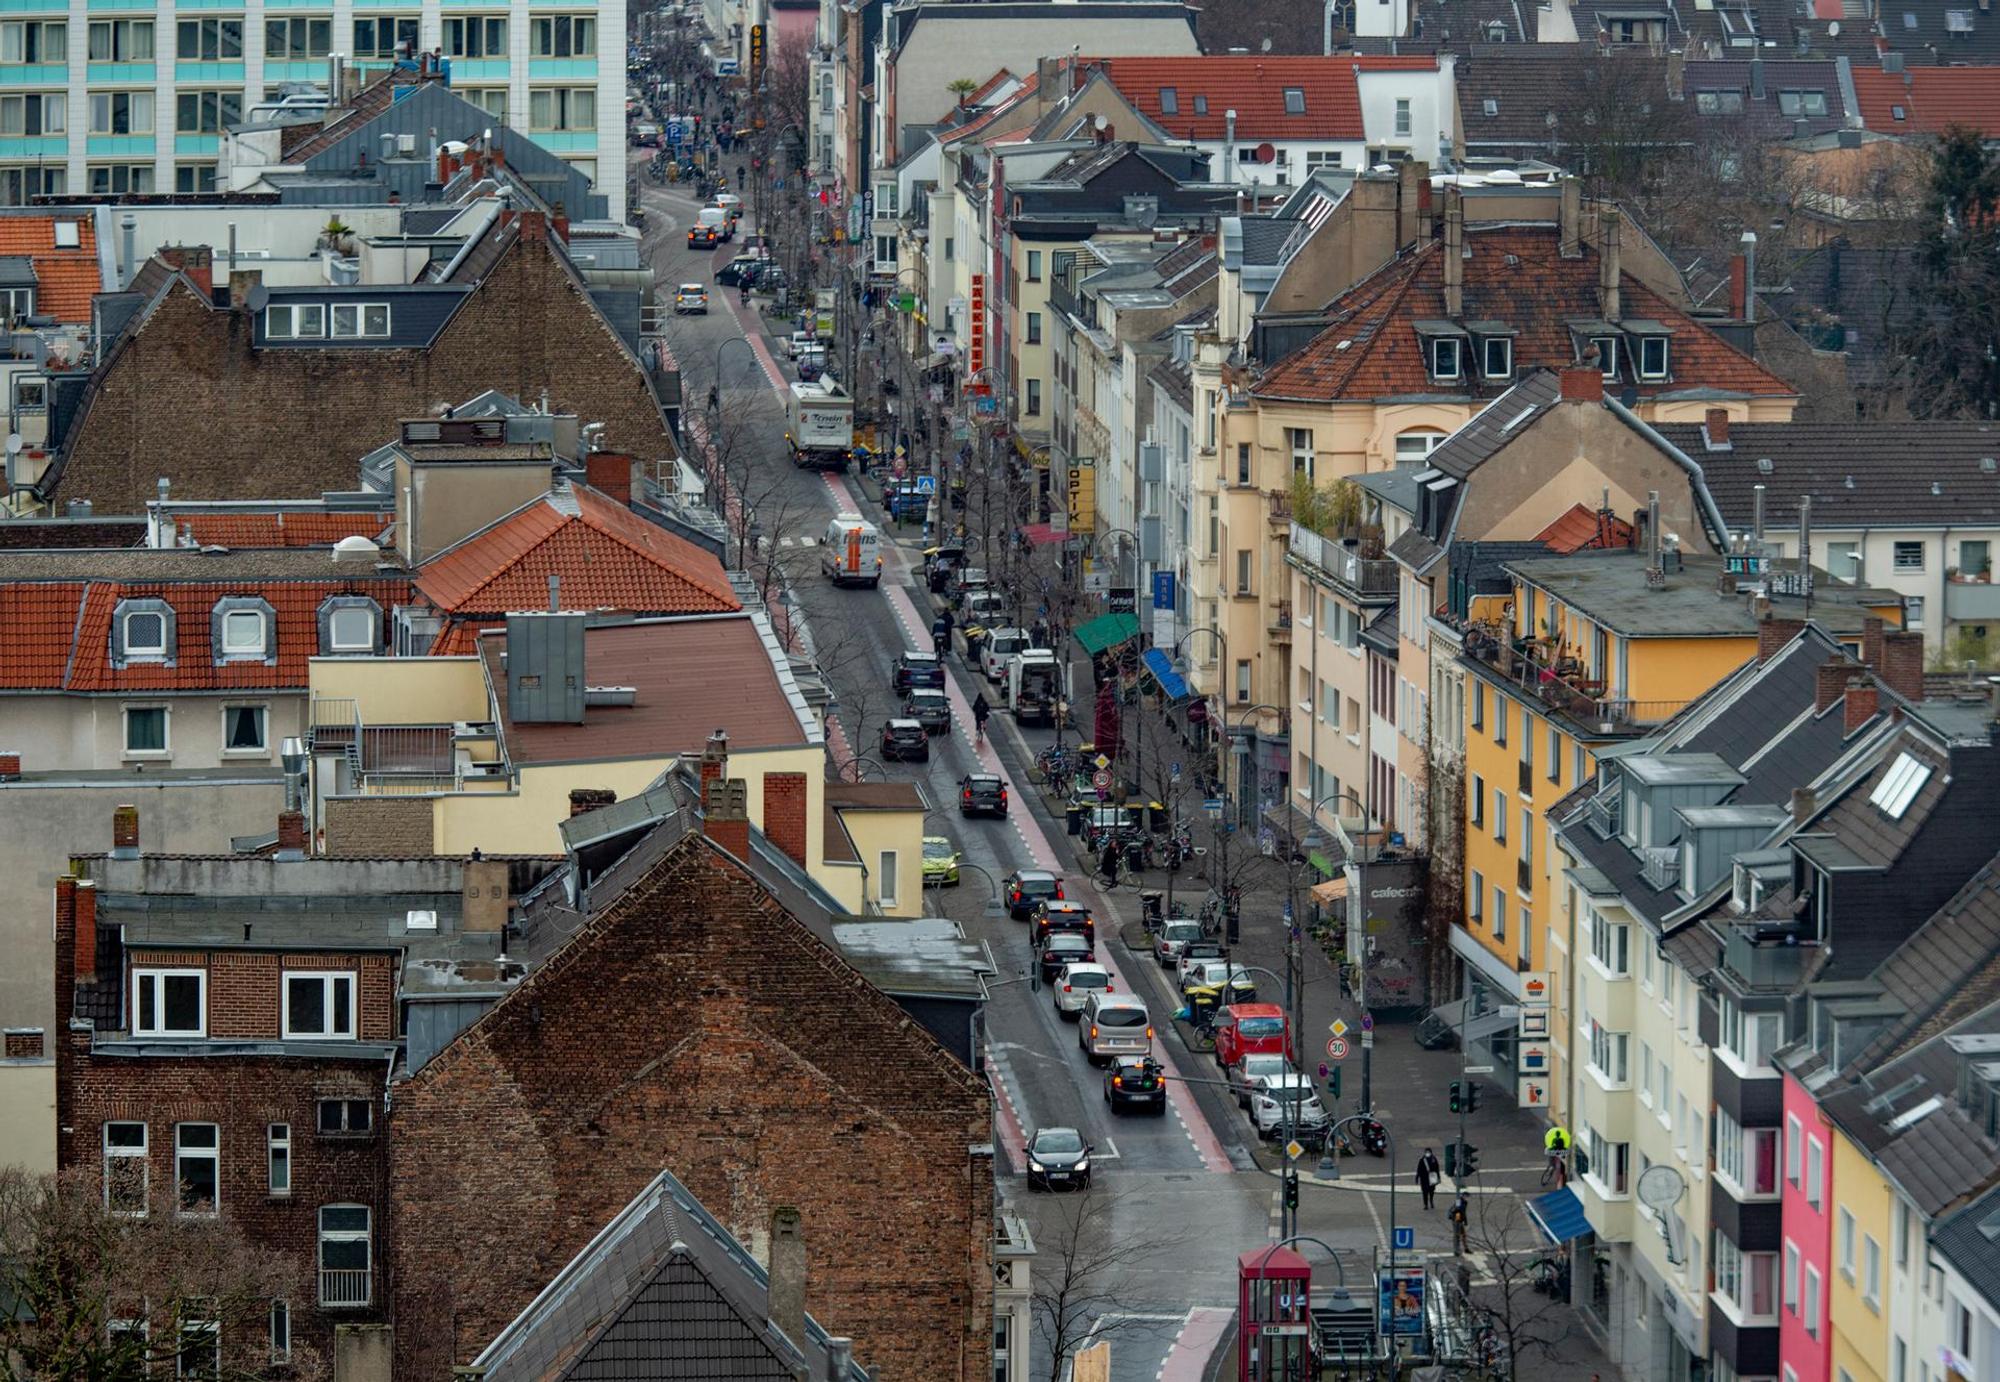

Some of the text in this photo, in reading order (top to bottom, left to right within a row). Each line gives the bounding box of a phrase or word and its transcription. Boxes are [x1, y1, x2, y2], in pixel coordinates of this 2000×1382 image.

[1069, 469, 1080, 522] OPTIK
[1331, 1042, 1344, 1053] 30
[1396, 1230, 1410, 1247] U
[1280, 1295, 1291, 1307] U
